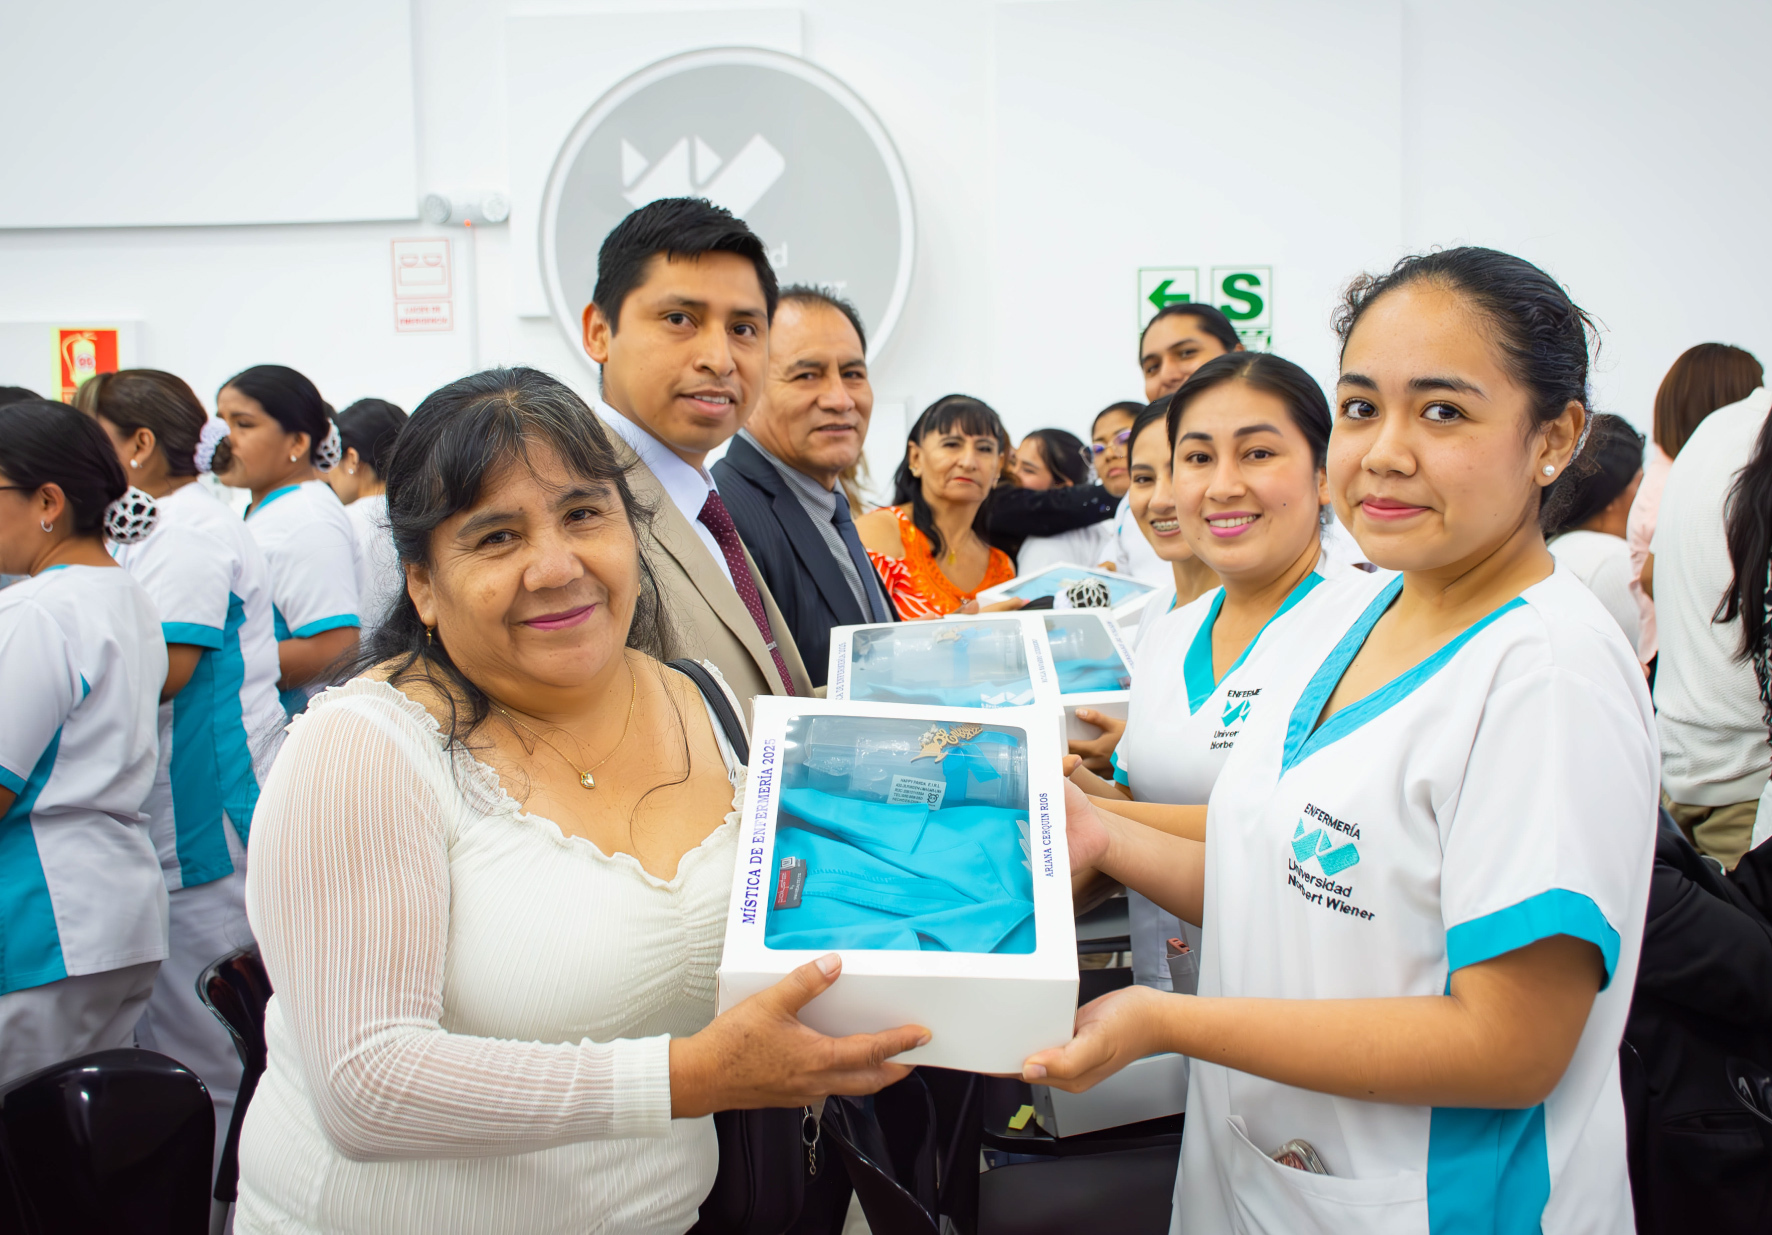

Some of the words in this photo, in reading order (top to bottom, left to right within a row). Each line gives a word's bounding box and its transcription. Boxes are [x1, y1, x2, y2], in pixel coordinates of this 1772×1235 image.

[1220, 273, 1264, 321] S
[762, 738, 777, 766] 2025
[751, 767, 774, 844] ENFERMERÍA
[1303, 802, 1361, 841] ENFERMERÍA
[1040, 812, 1053, 846] CERQUIN
[749, 847, 764, 865] DE
[1043, 847, 1054, 878] ARIANA
[740, 868, 762, 925] MÍSTICA
[1287, 873, 1324, 906] Norbert
[1326, 896, 1376, 921] Wiener
[1288, 857, 1353, 898] Universidad
